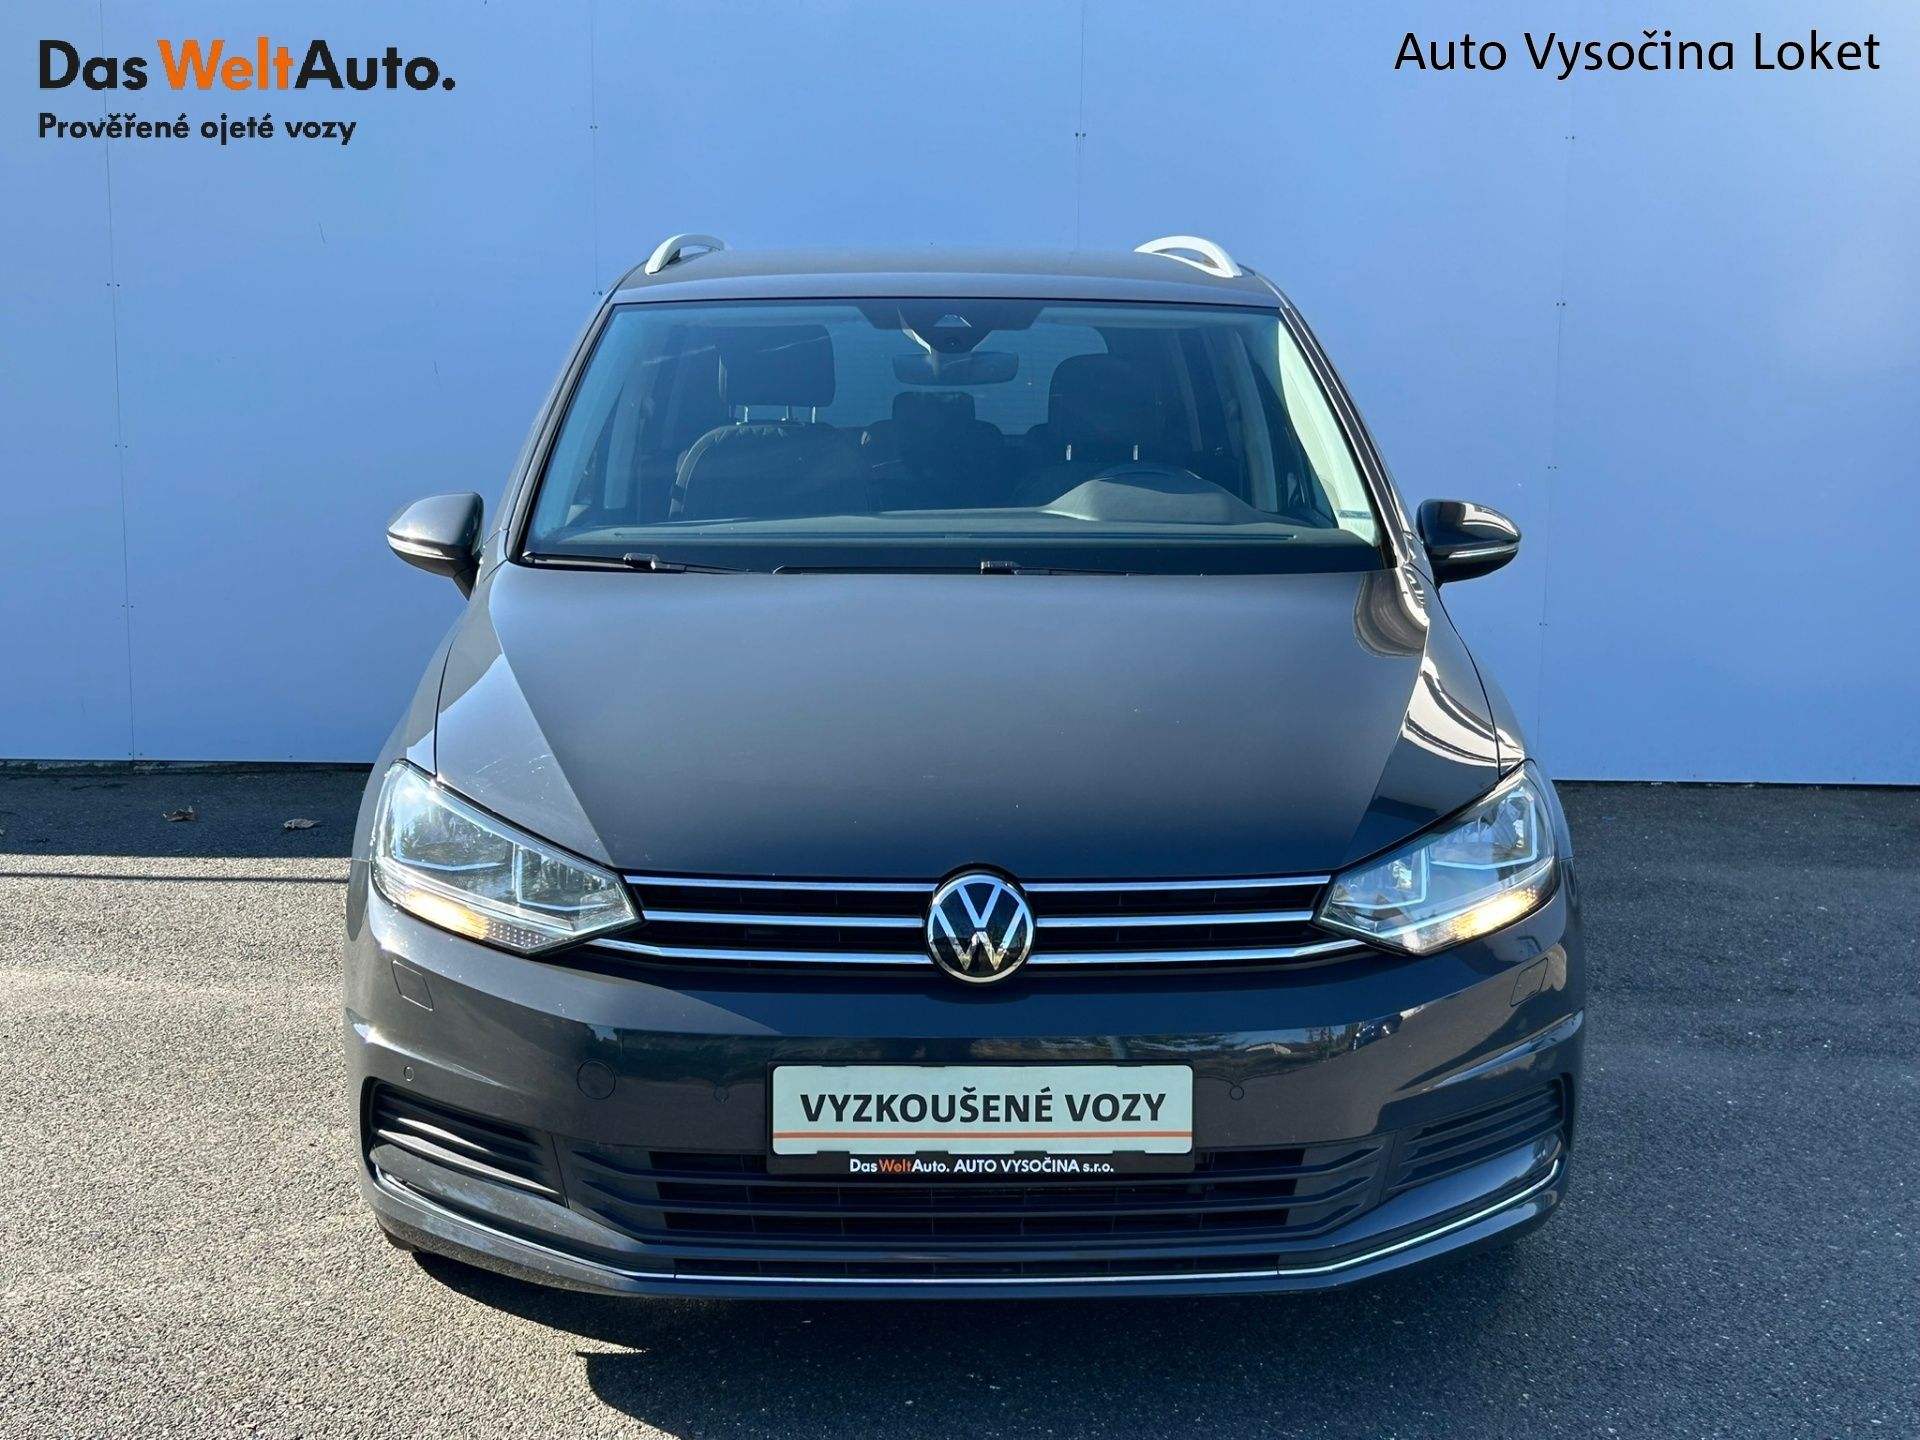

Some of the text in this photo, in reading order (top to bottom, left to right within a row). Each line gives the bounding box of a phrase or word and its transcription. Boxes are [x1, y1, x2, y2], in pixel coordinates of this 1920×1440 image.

[800, 1086, 1166, 1123] VYZKOUŠENÉ VOZY
[954, 1159, 998, 1173] AUTO
[1001, 1155, 1080, 1173] VYSOČINA
[1083, 1163, 1114, 1173] s.r.o.
